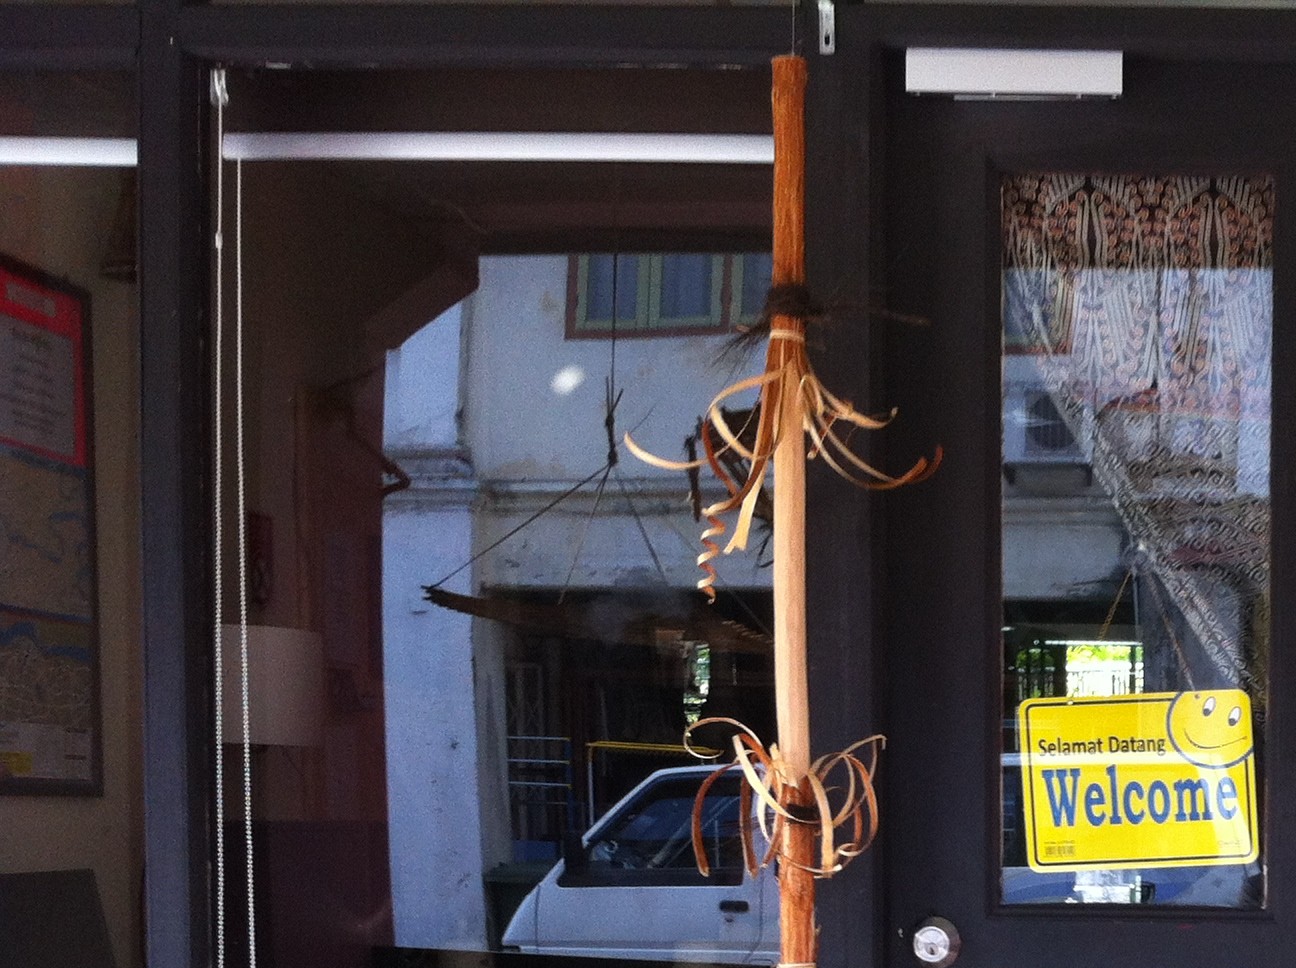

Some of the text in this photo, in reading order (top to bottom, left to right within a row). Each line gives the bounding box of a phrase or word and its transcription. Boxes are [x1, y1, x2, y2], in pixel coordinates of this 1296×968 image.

[1038, 735, 1166, 756] Selamat Datang
[1041, 764, 1239, 828] Welcome
